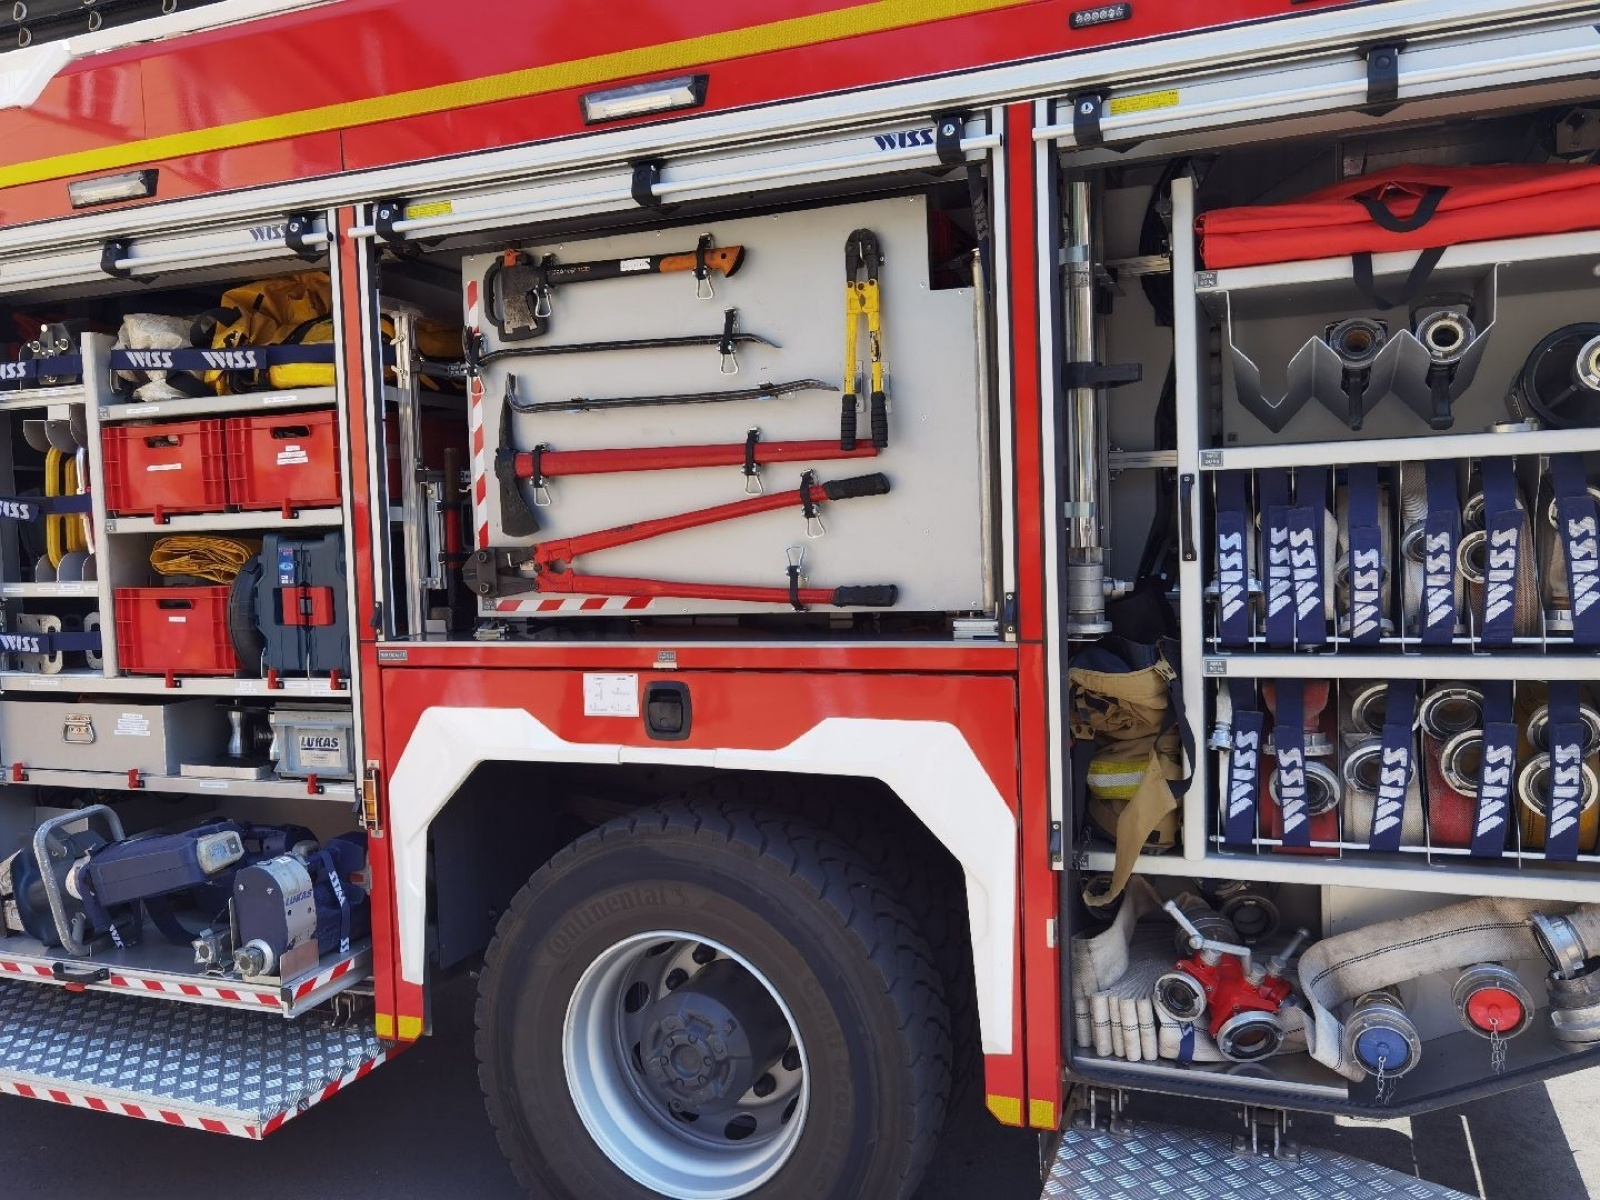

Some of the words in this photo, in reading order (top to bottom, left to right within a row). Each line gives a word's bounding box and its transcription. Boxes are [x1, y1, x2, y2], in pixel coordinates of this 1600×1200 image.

[874, 129, 934, 151] WISS
[125, 350, 174, 369] WISS
[200, 349, 258, 369] WISS
[1219, 531, 1242, 621] WISS
[1289, 527, 1321, 621] WISS
[1352, 548, 1380, 639] WISS
[1425, 530, 1453, 628] WISS
[1485, 526, 1518, 623] WISS
[1568, 516, 1600, 617] WISS
[301, 736, 339, 749] LUKAS
[1229, 730, 1259, 819] WISS
[1277, 747, 1307, 834] WISS
[1373, 745, 1407, 836] WISS
[1476, 744, 1513, 837] WISS
[1549, 743, 1581, 838] WISS
[286, 888, 313, 906] LUKAS
